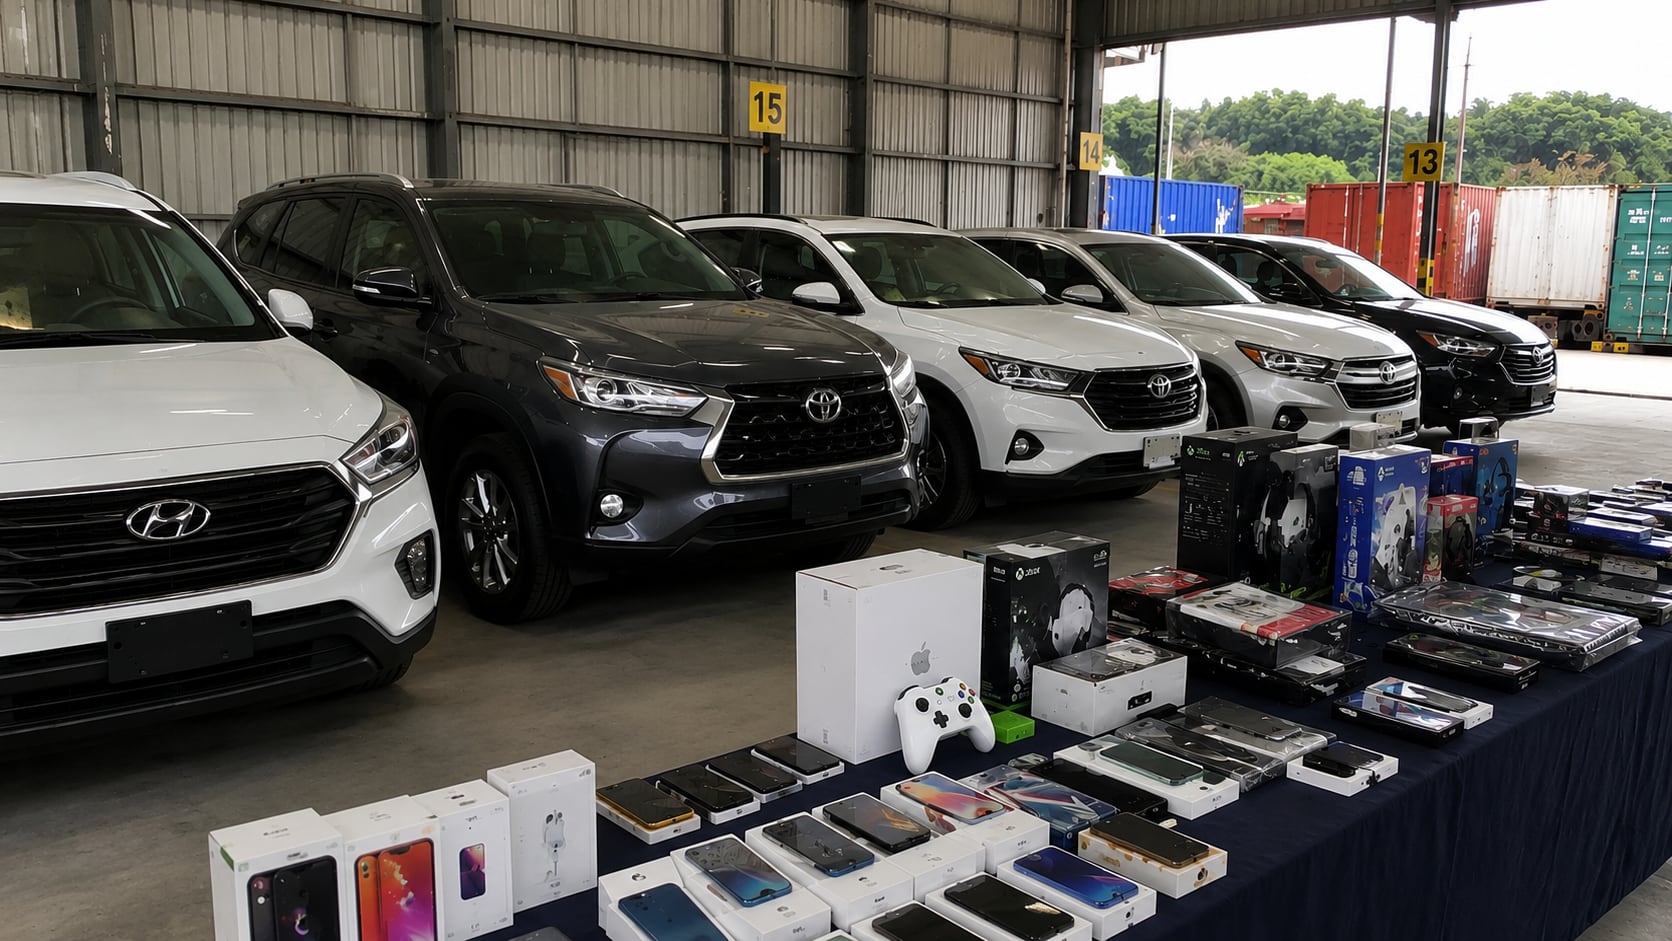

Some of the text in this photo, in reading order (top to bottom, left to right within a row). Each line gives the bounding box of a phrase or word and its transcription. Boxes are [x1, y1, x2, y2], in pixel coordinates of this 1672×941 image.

[754, 91, 782, 124] 15
[1083, 139, 1101, 164] 14
[1409, 149, 1438, 175] 13
